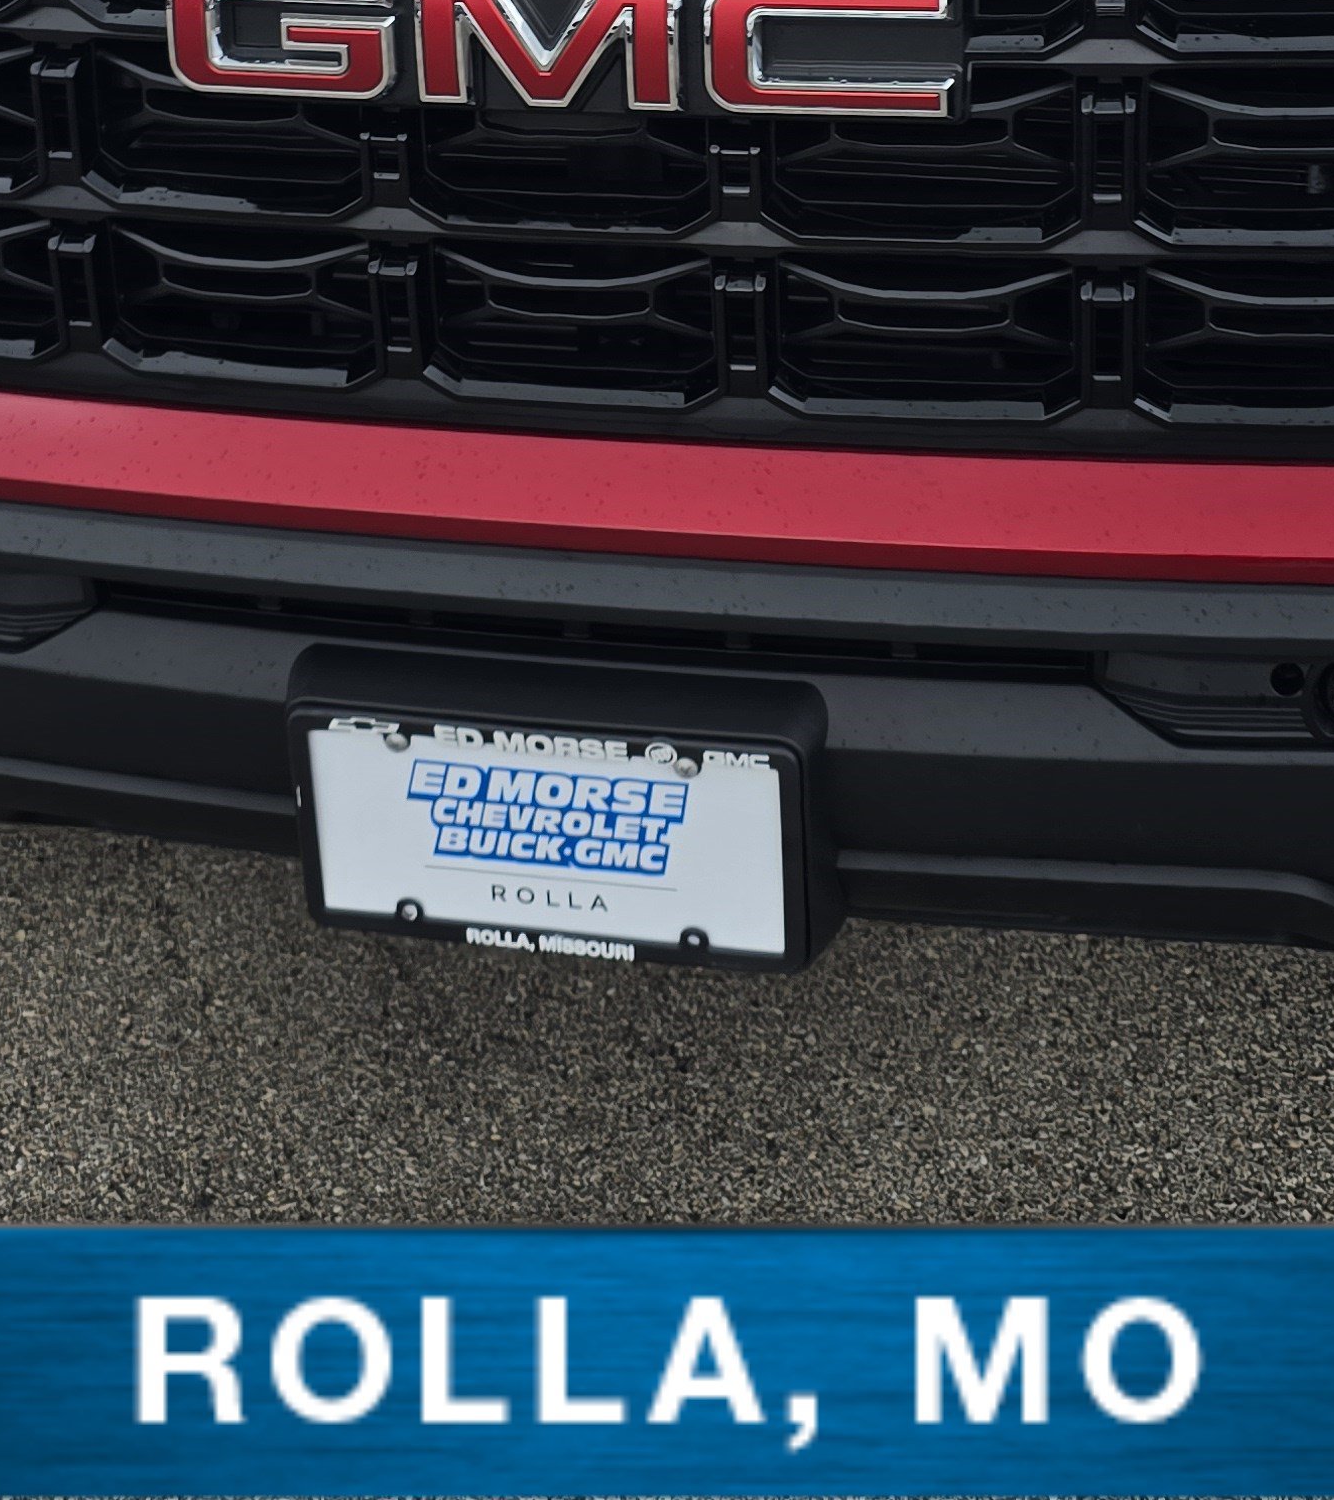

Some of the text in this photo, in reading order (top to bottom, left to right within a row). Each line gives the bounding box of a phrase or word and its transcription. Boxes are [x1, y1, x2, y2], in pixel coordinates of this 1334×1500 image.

[433, 723, 629, 764] ED MORSE
[409, 760, 689, 819] ED MORSE
[490, 884, 609, 913] ROLLA
[465, 927, 636, 963] ROLLA, MISSOURI
